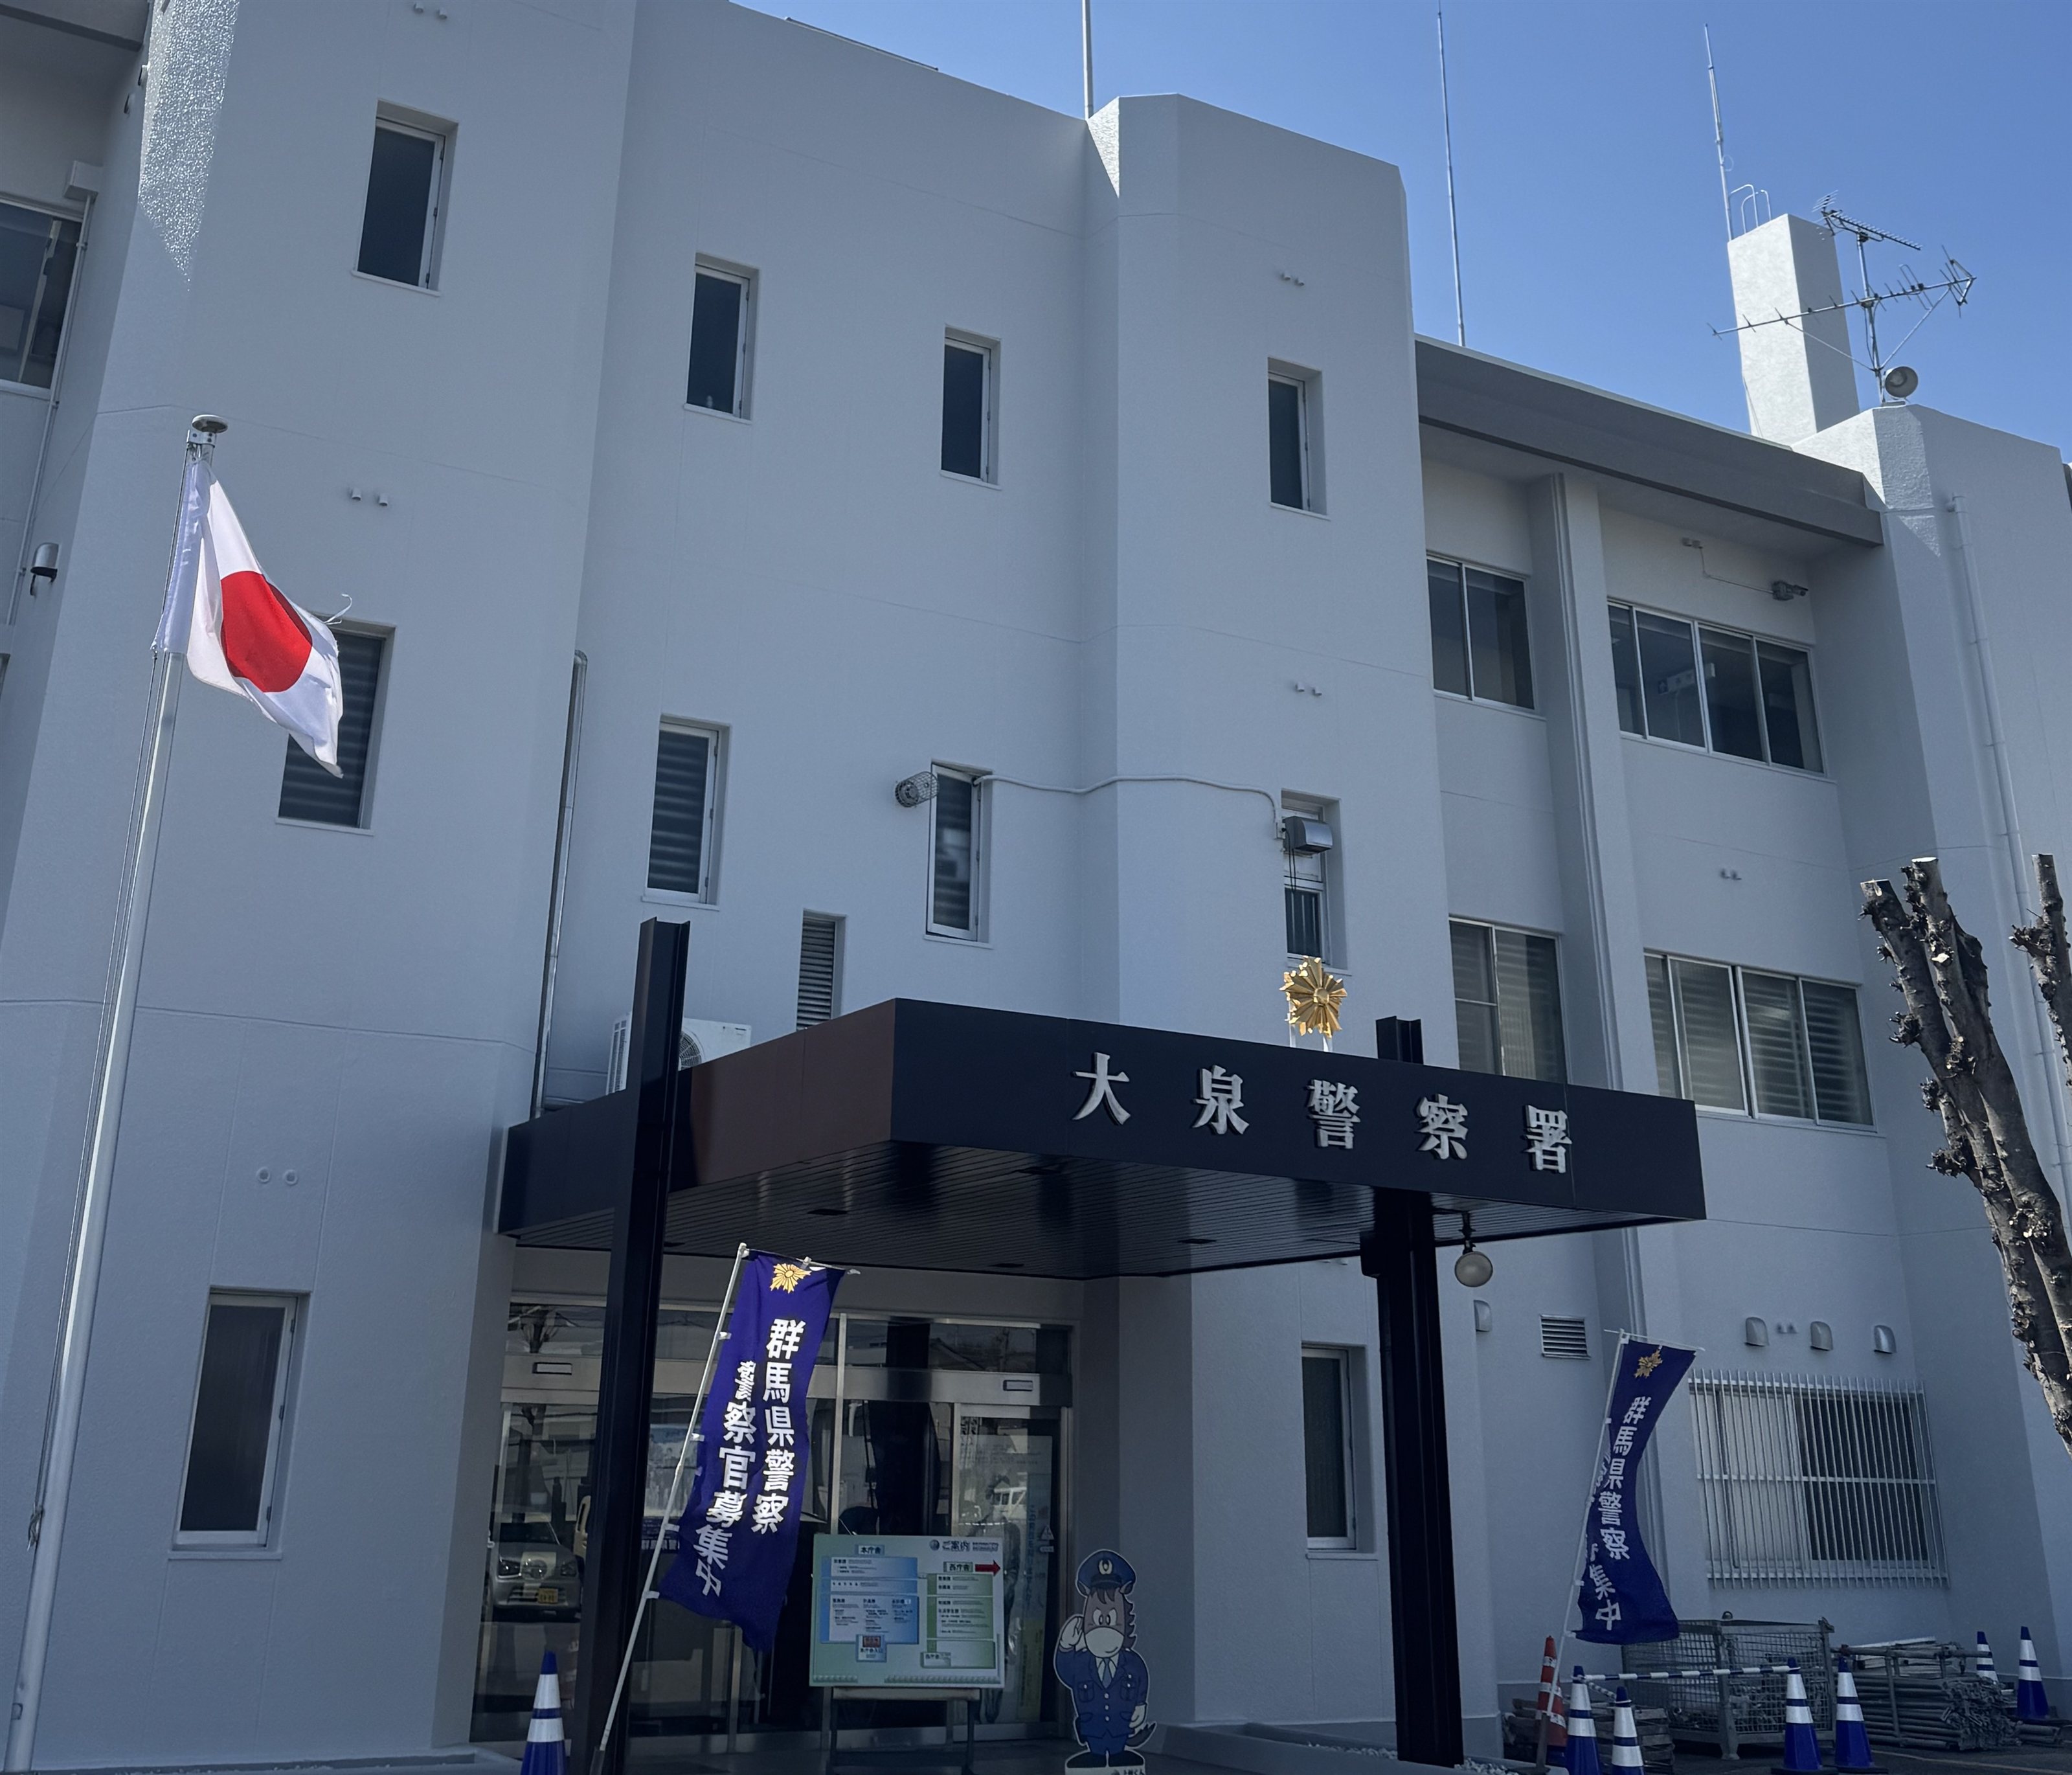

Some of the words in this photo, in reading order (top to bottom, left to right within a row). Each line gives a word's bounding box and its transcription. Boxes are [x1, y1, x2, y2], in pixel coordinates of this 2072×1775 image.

[1072, 1052, 1573, 1173] 大泉警察署
[693, 1360, 757, 1597] 警察官募集中
[751, 1318, 805, 1535] 群馬県警察
[1598, 1396, 1652, 1560] 群馬県警察
[942, 1541, 970, 1552] ご案内
